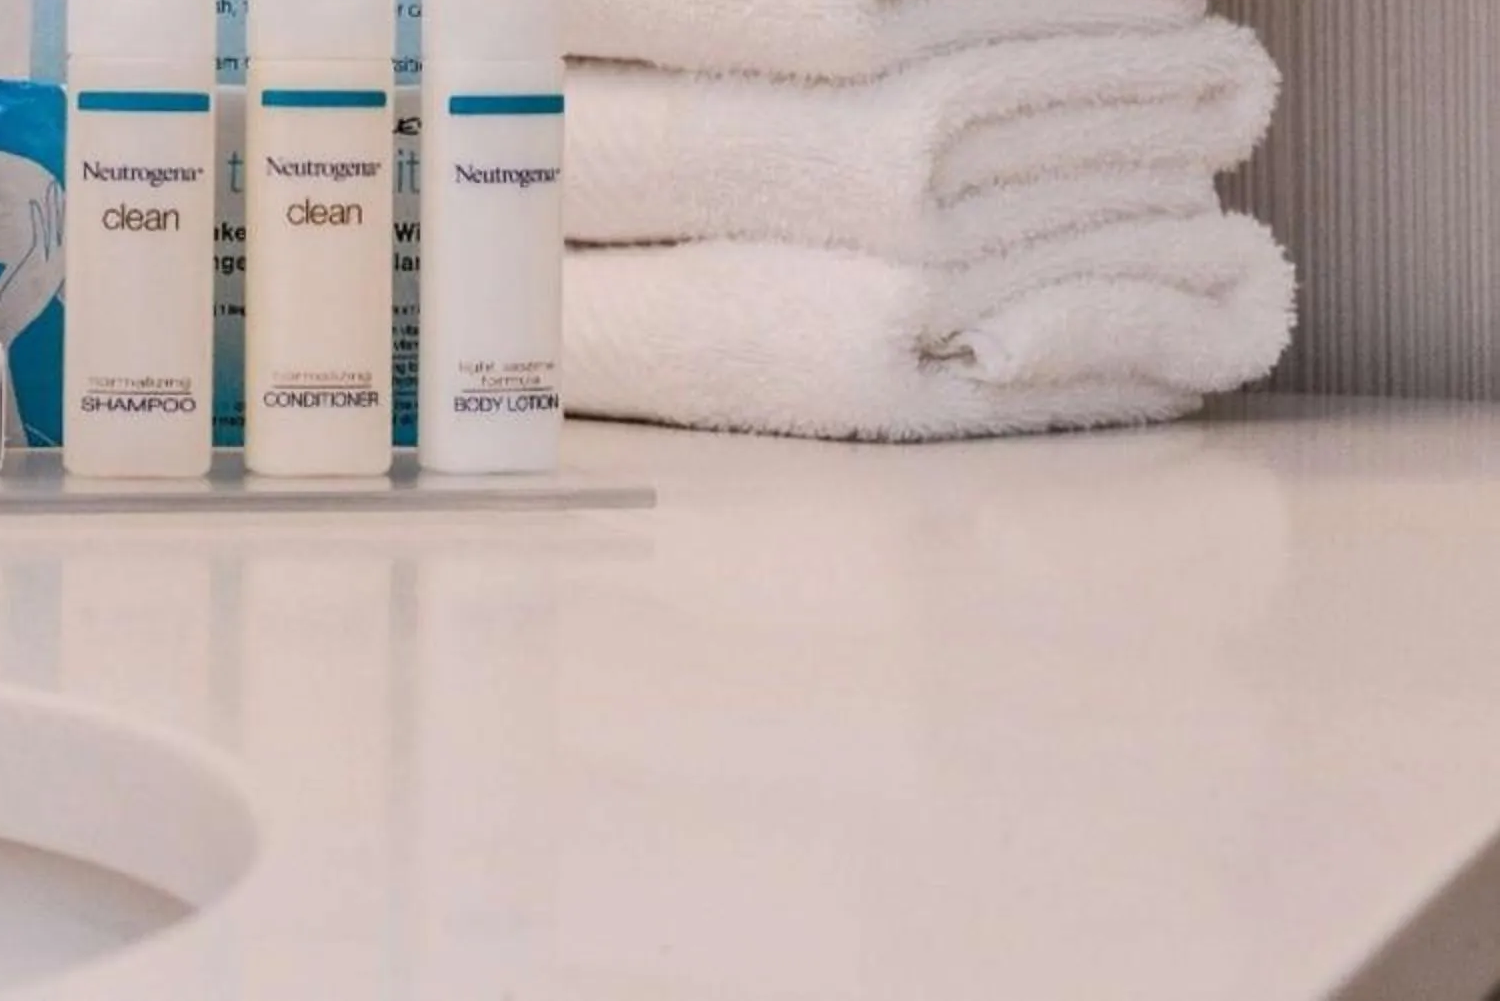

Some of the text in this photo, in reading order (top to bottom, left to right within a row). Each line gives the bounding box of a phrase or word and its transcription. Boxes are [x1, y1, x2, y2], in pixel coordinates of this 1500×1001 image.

[82, 160, 197, 187] Neutrogena
[266, 156, 378, 182] Neutrogena
[453, 163, 557, 188] Neutrogena
[101, 202, 180, 232] clean
[285, 197, 363, 226] clean
[80, 395, 197, 413] SHAMPOO
[262, 390, 379, 408] CONDITIONER
[452, 392, 560, 413] BODY LOTION
